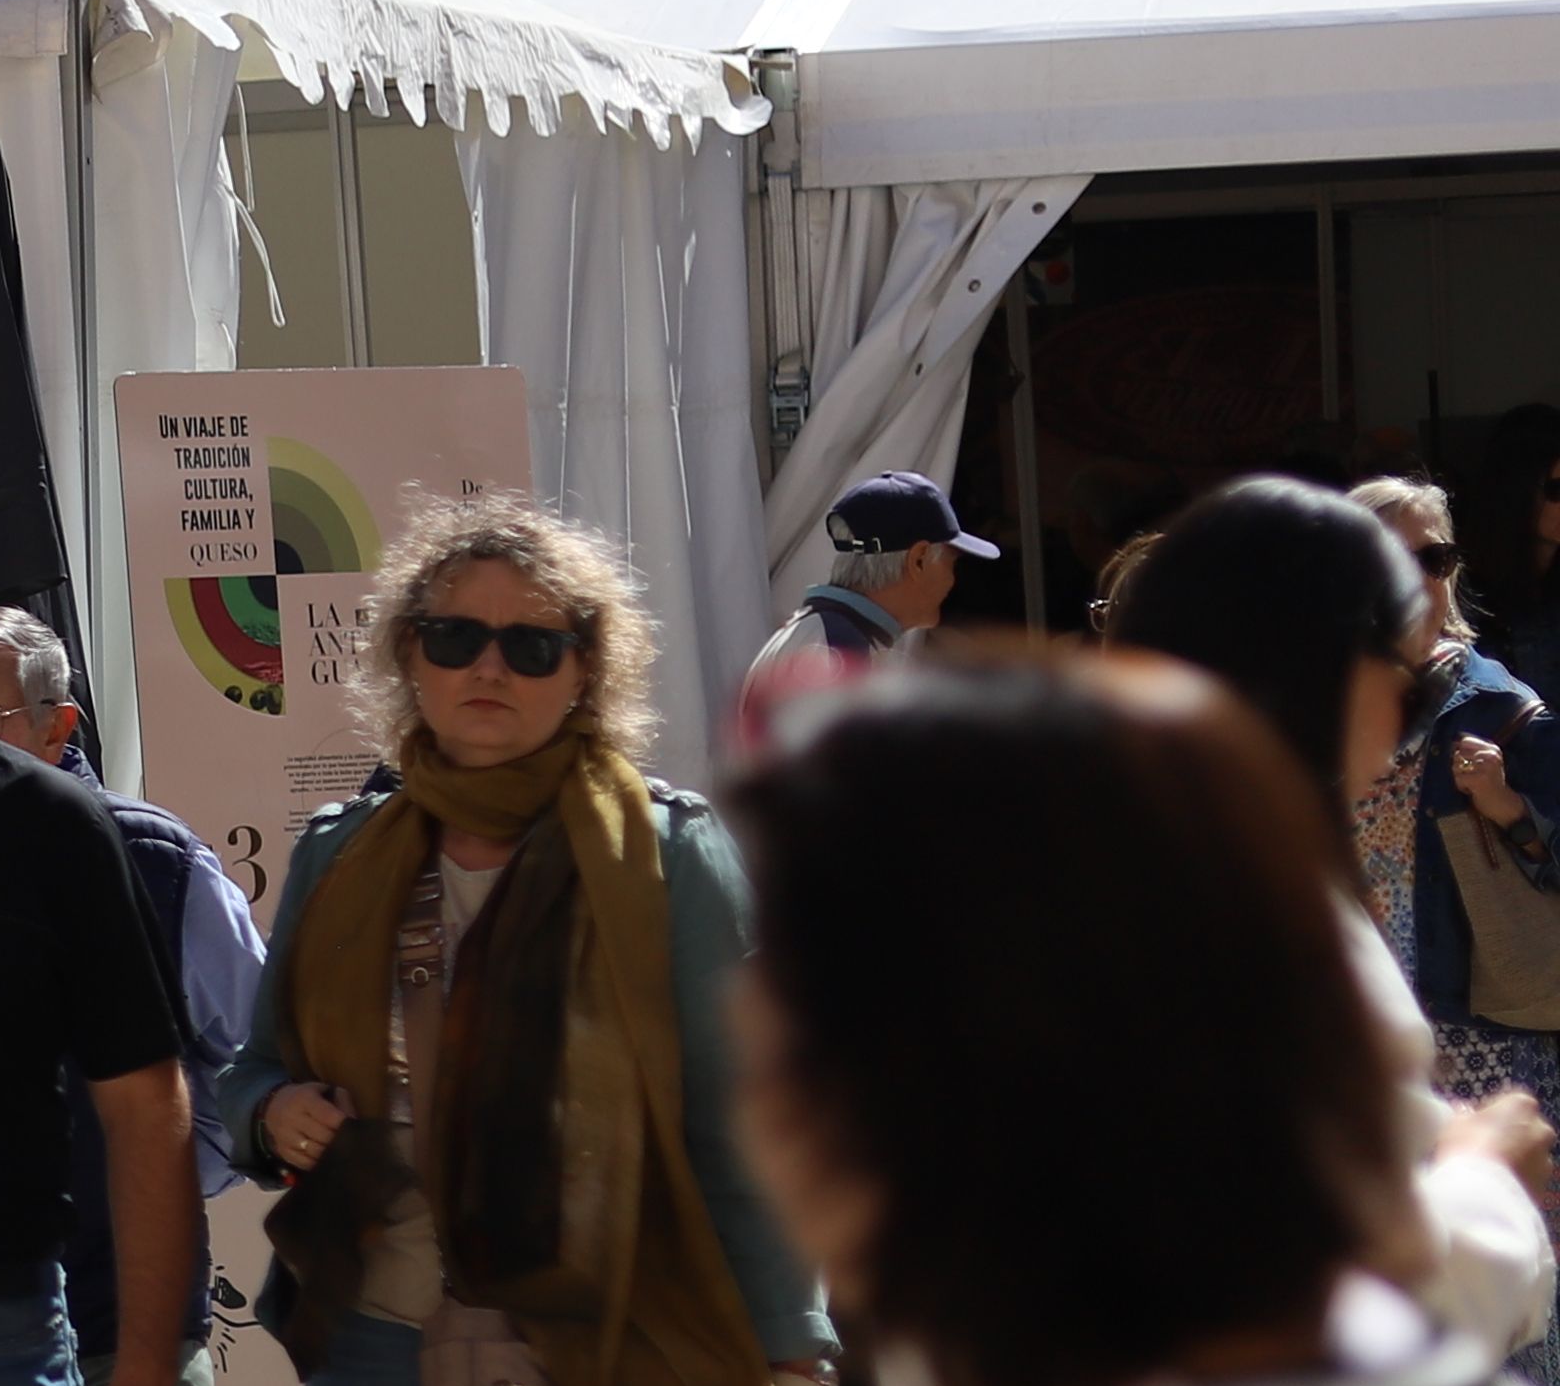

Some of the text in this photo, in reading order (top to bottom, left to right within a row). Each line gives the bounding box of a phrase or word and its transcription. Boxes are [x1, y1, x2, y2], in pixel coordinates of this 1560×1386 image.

[183, 415, 225, 438] VIAJE
[230, 415, 248, 437] DE
[174, 443, 251, 470] TRADICIÓN
[184, 477, 254, 502] CULTURA,
[461, 479, 483, 496] De
[181, 508, 256, 532] FAMILIA Y
[190, 543, 258, 567] QUESO
[307, 602, 341, 629] LA
[227, 825, 267, 905] 3
